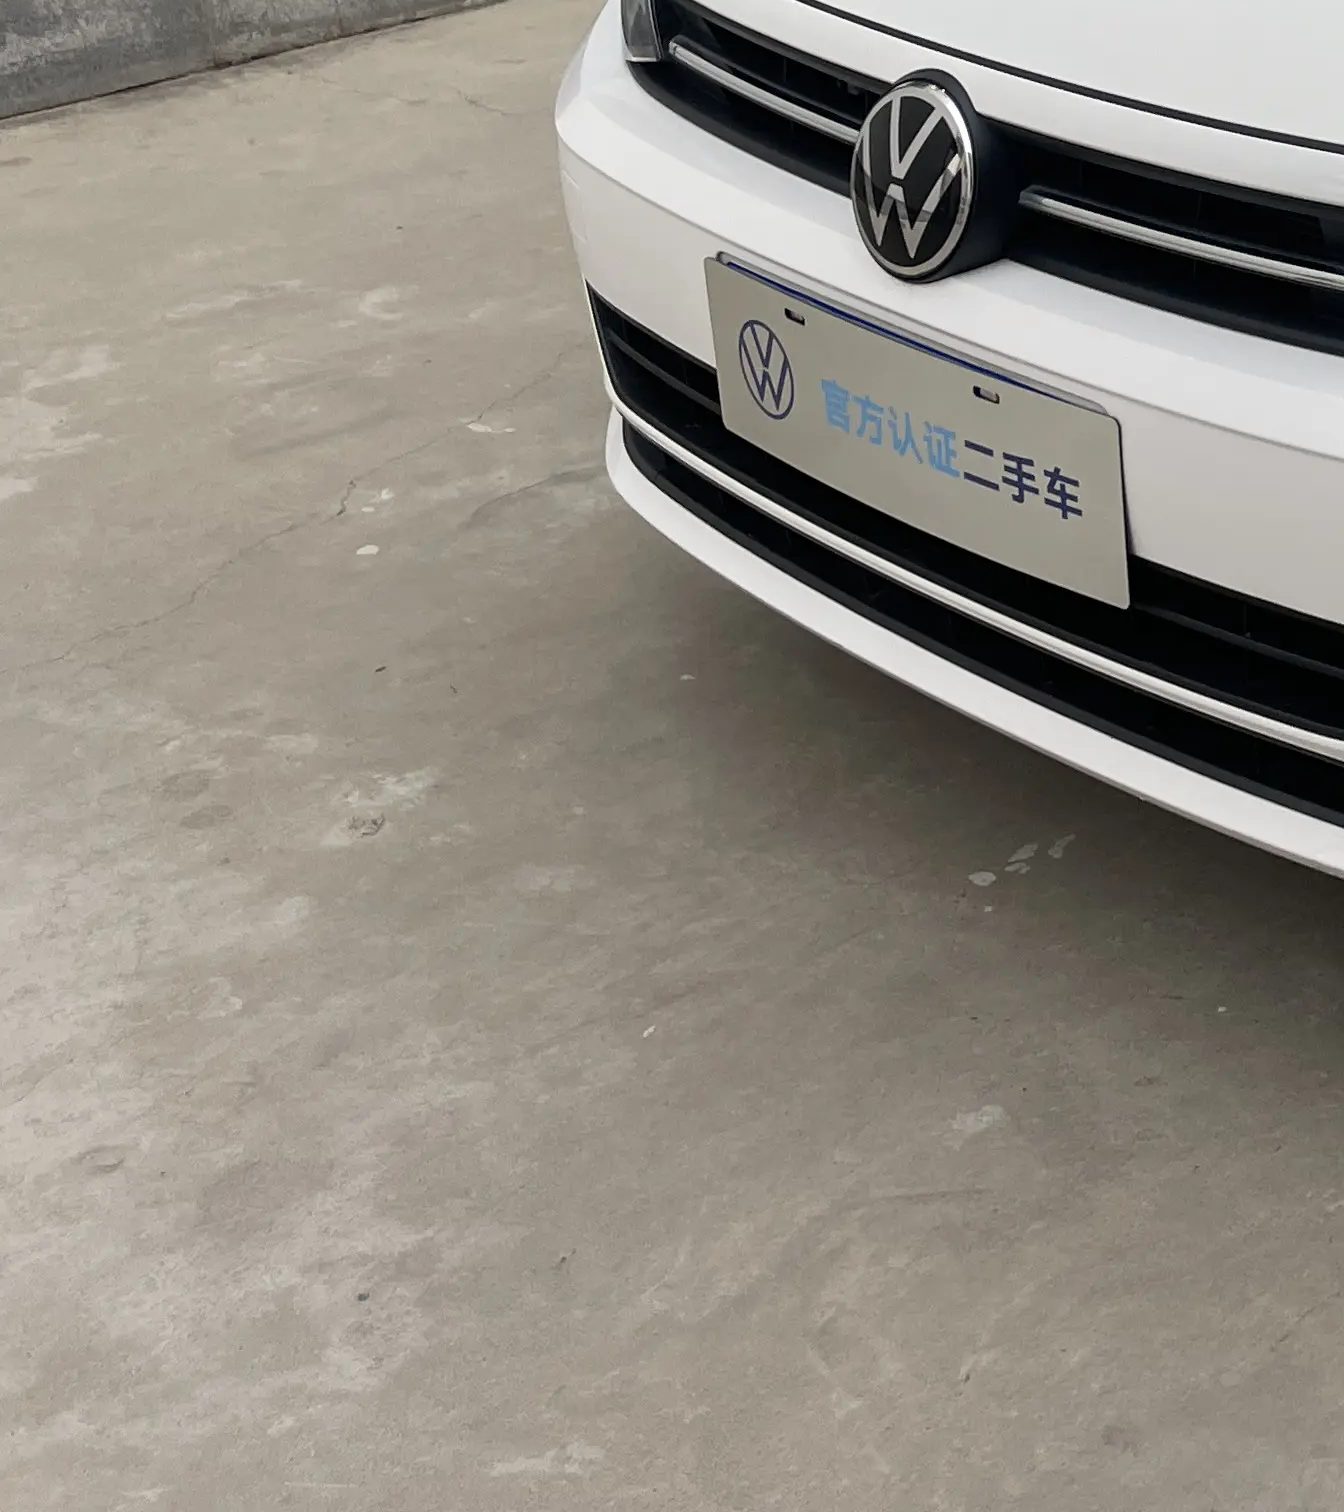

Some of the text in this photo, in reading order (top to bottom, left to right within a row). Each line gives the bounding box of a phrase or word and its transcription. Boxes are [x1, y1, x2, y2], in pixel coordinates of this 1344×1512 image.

[820, 378, 1084, 520] 官方认证二手车
